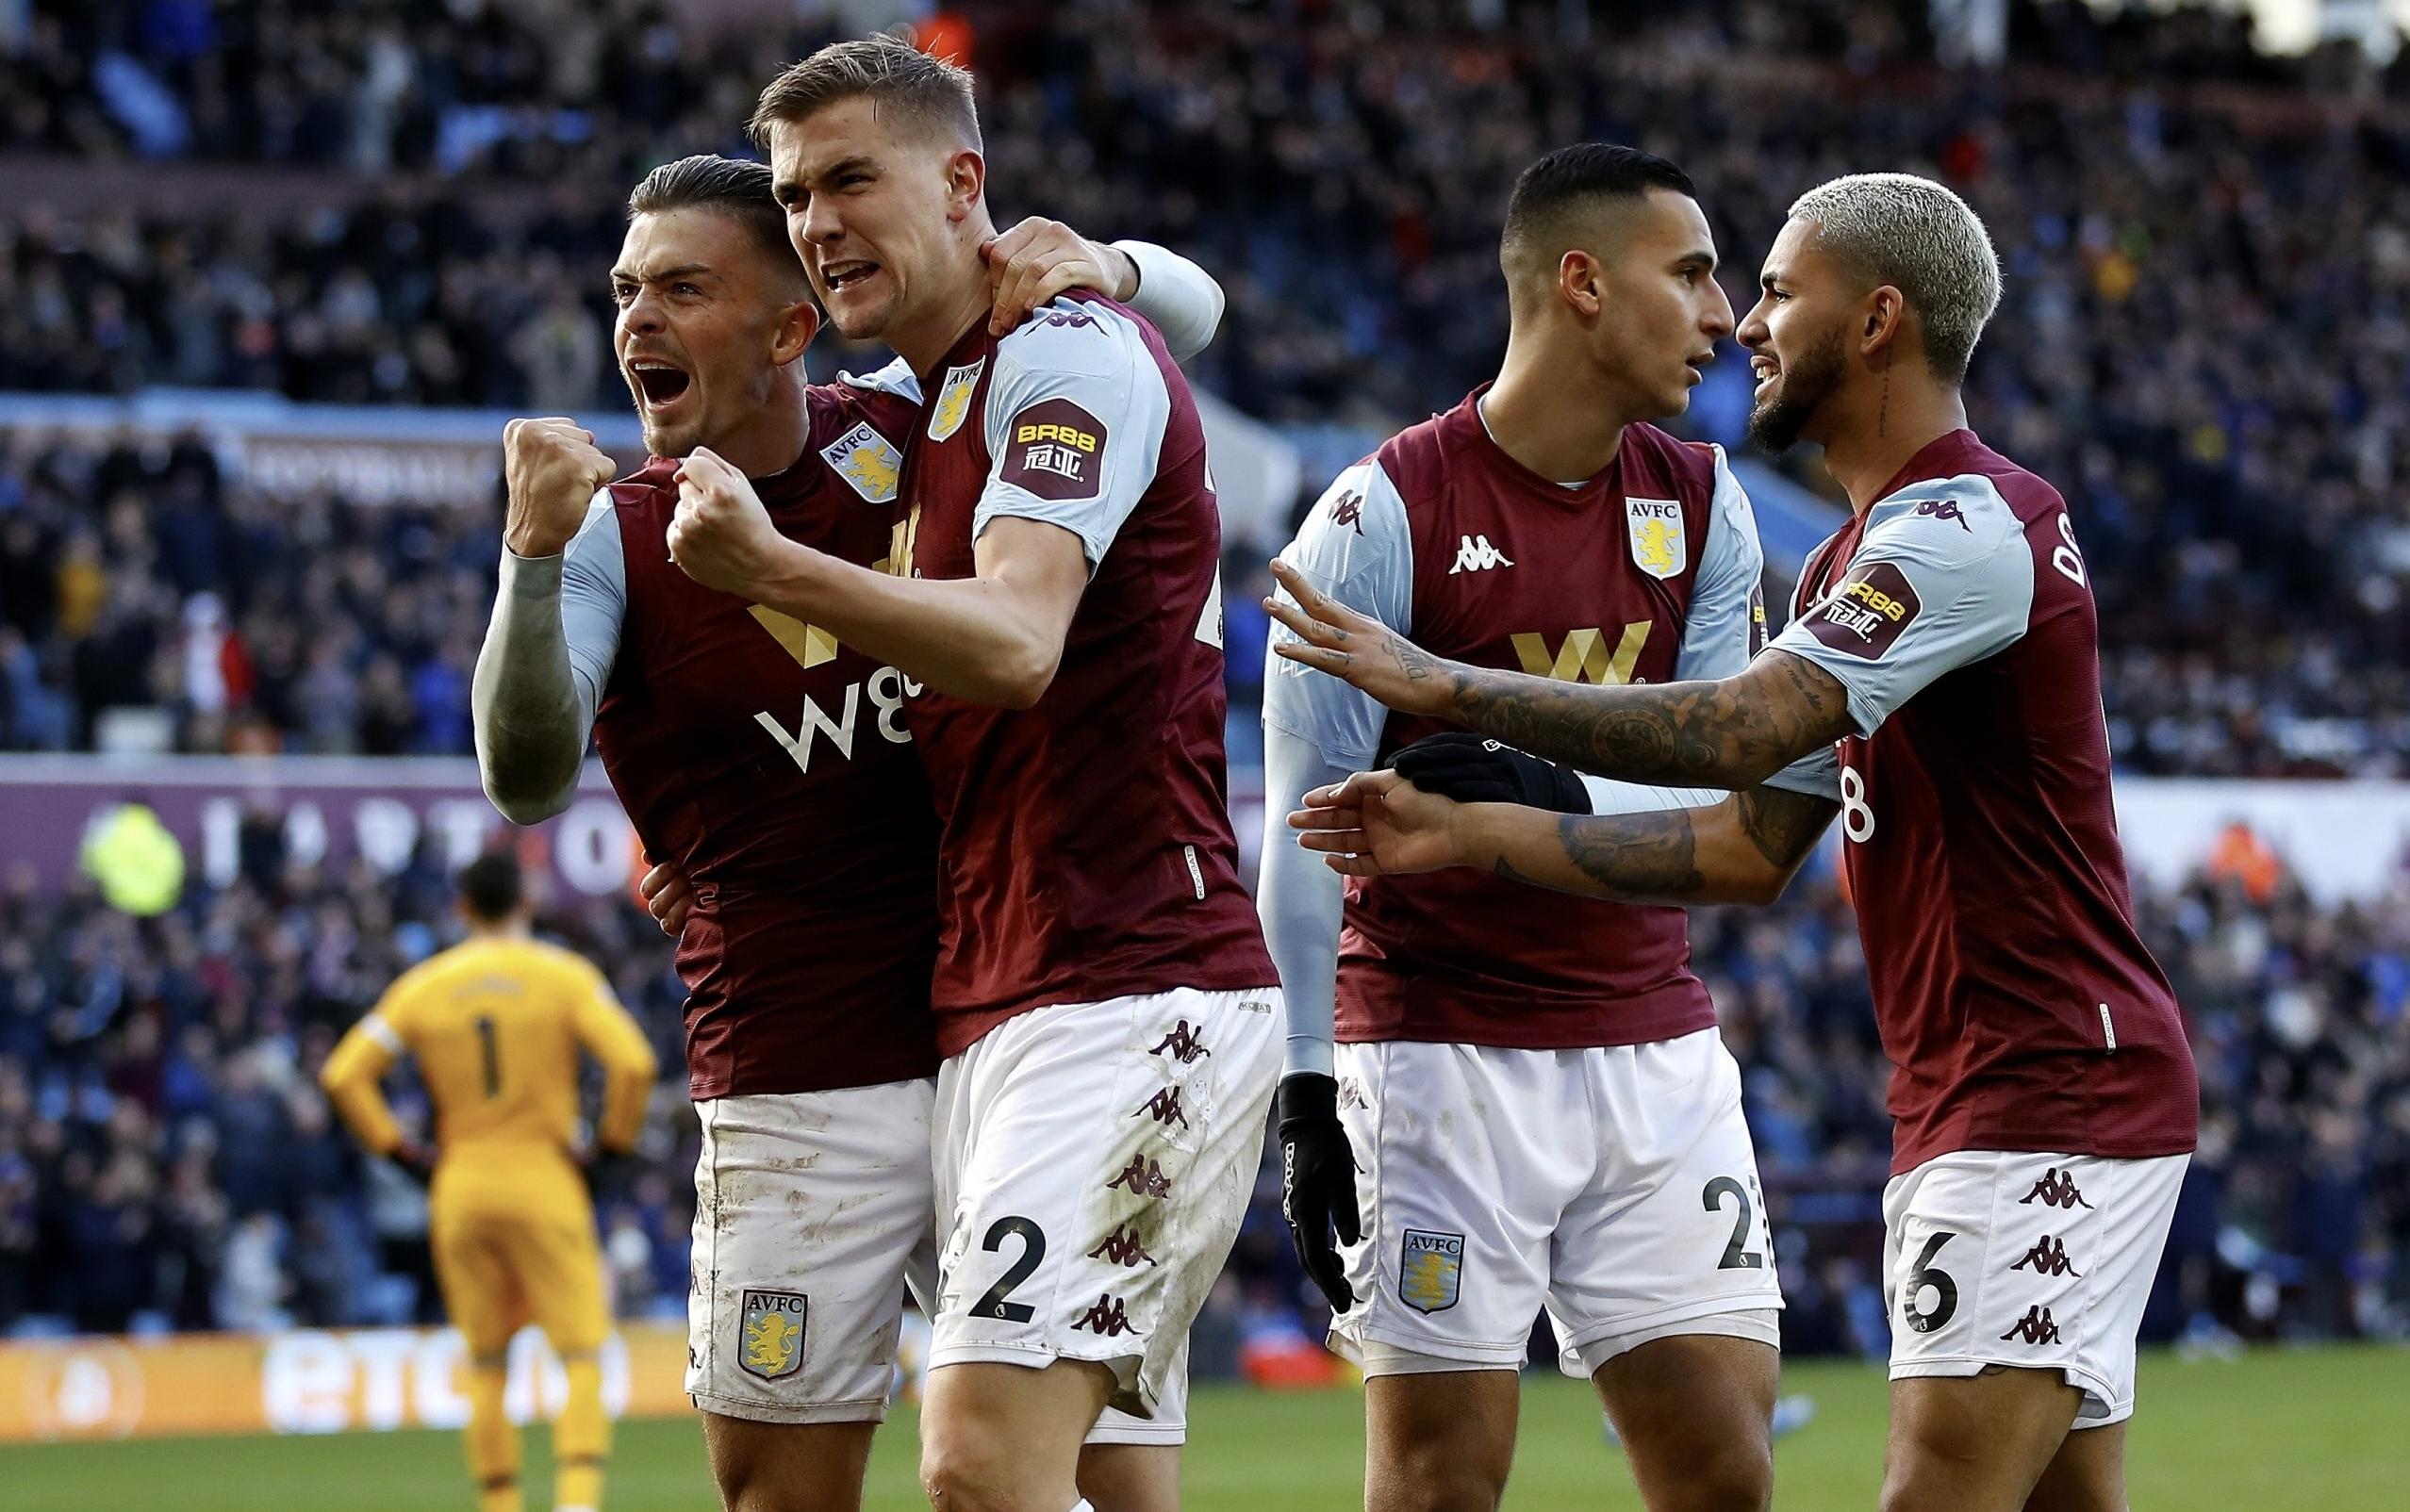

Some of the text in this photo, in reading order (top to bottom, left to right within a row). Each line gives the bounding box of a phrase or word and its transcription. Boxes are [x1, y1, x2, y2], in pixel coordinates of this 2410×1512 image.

[830, 429, 873, 464] AVFC
[1017, 424, 1097, 452] BR88
[1631, 502, 1677, 518] AVFC
[476, 1015, 502, 1099] 1
[1408, 1236, 1461, 1254] AVFC
[1905, 1231, 1959, 1334] 6
[747, 1294, 802, 1313] AVFC
